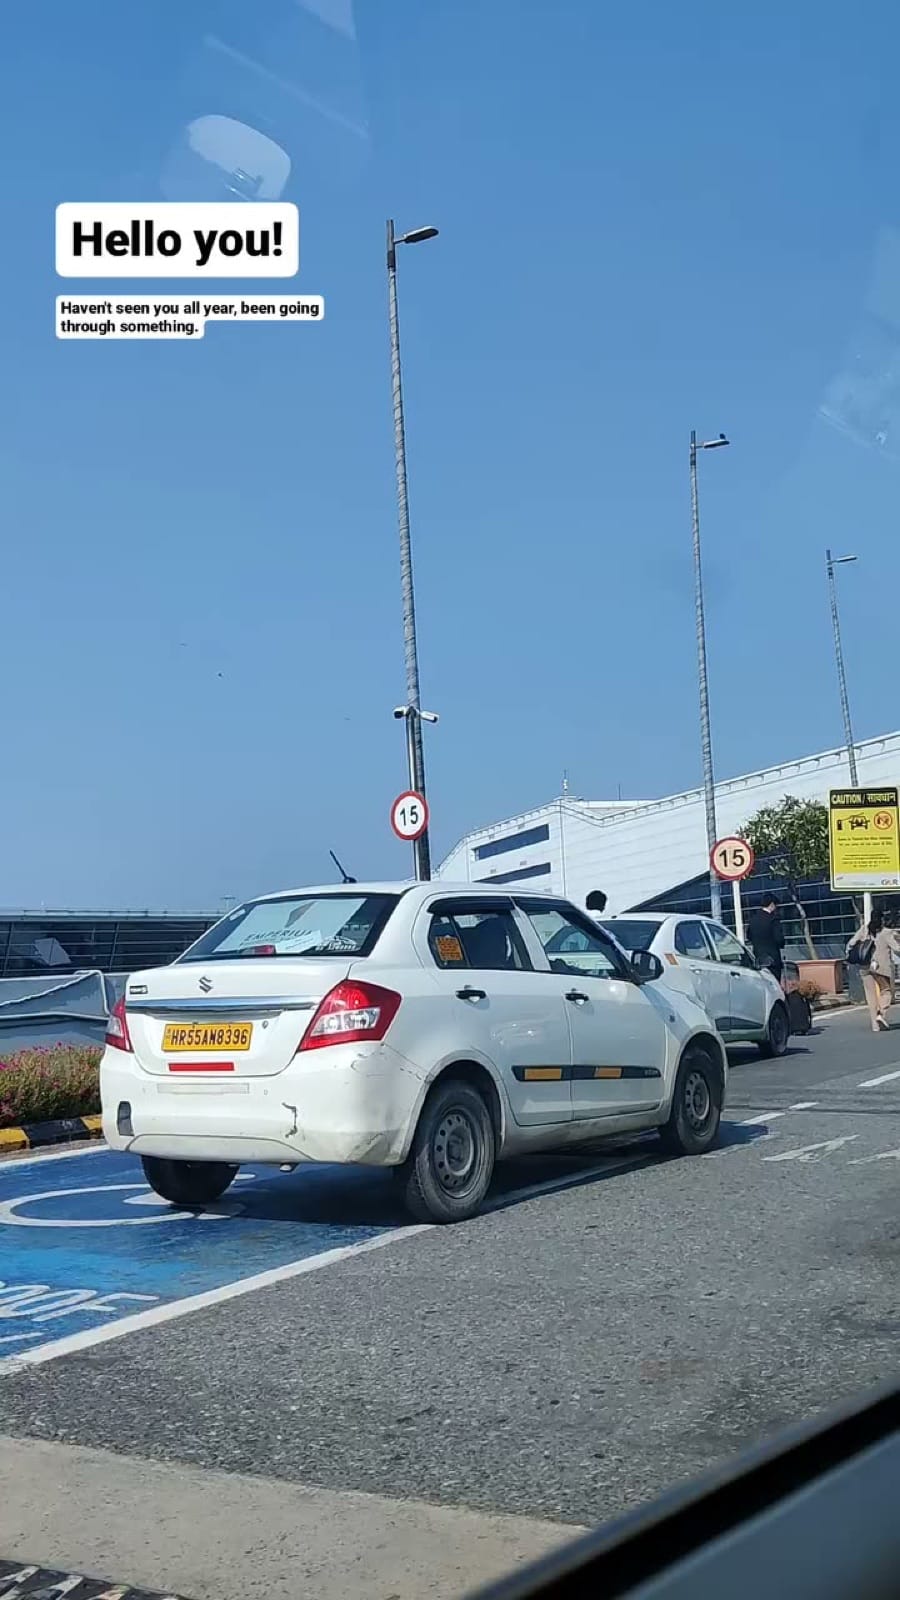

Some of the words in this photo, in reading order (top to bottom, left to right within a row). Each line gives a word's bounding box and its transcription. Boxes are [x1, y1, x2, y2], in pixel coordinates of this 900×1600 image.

[831, 793, 861, 805] CAUTION
[400, 805, 418, 826] 15
[719, 849, 745, 867] 15
